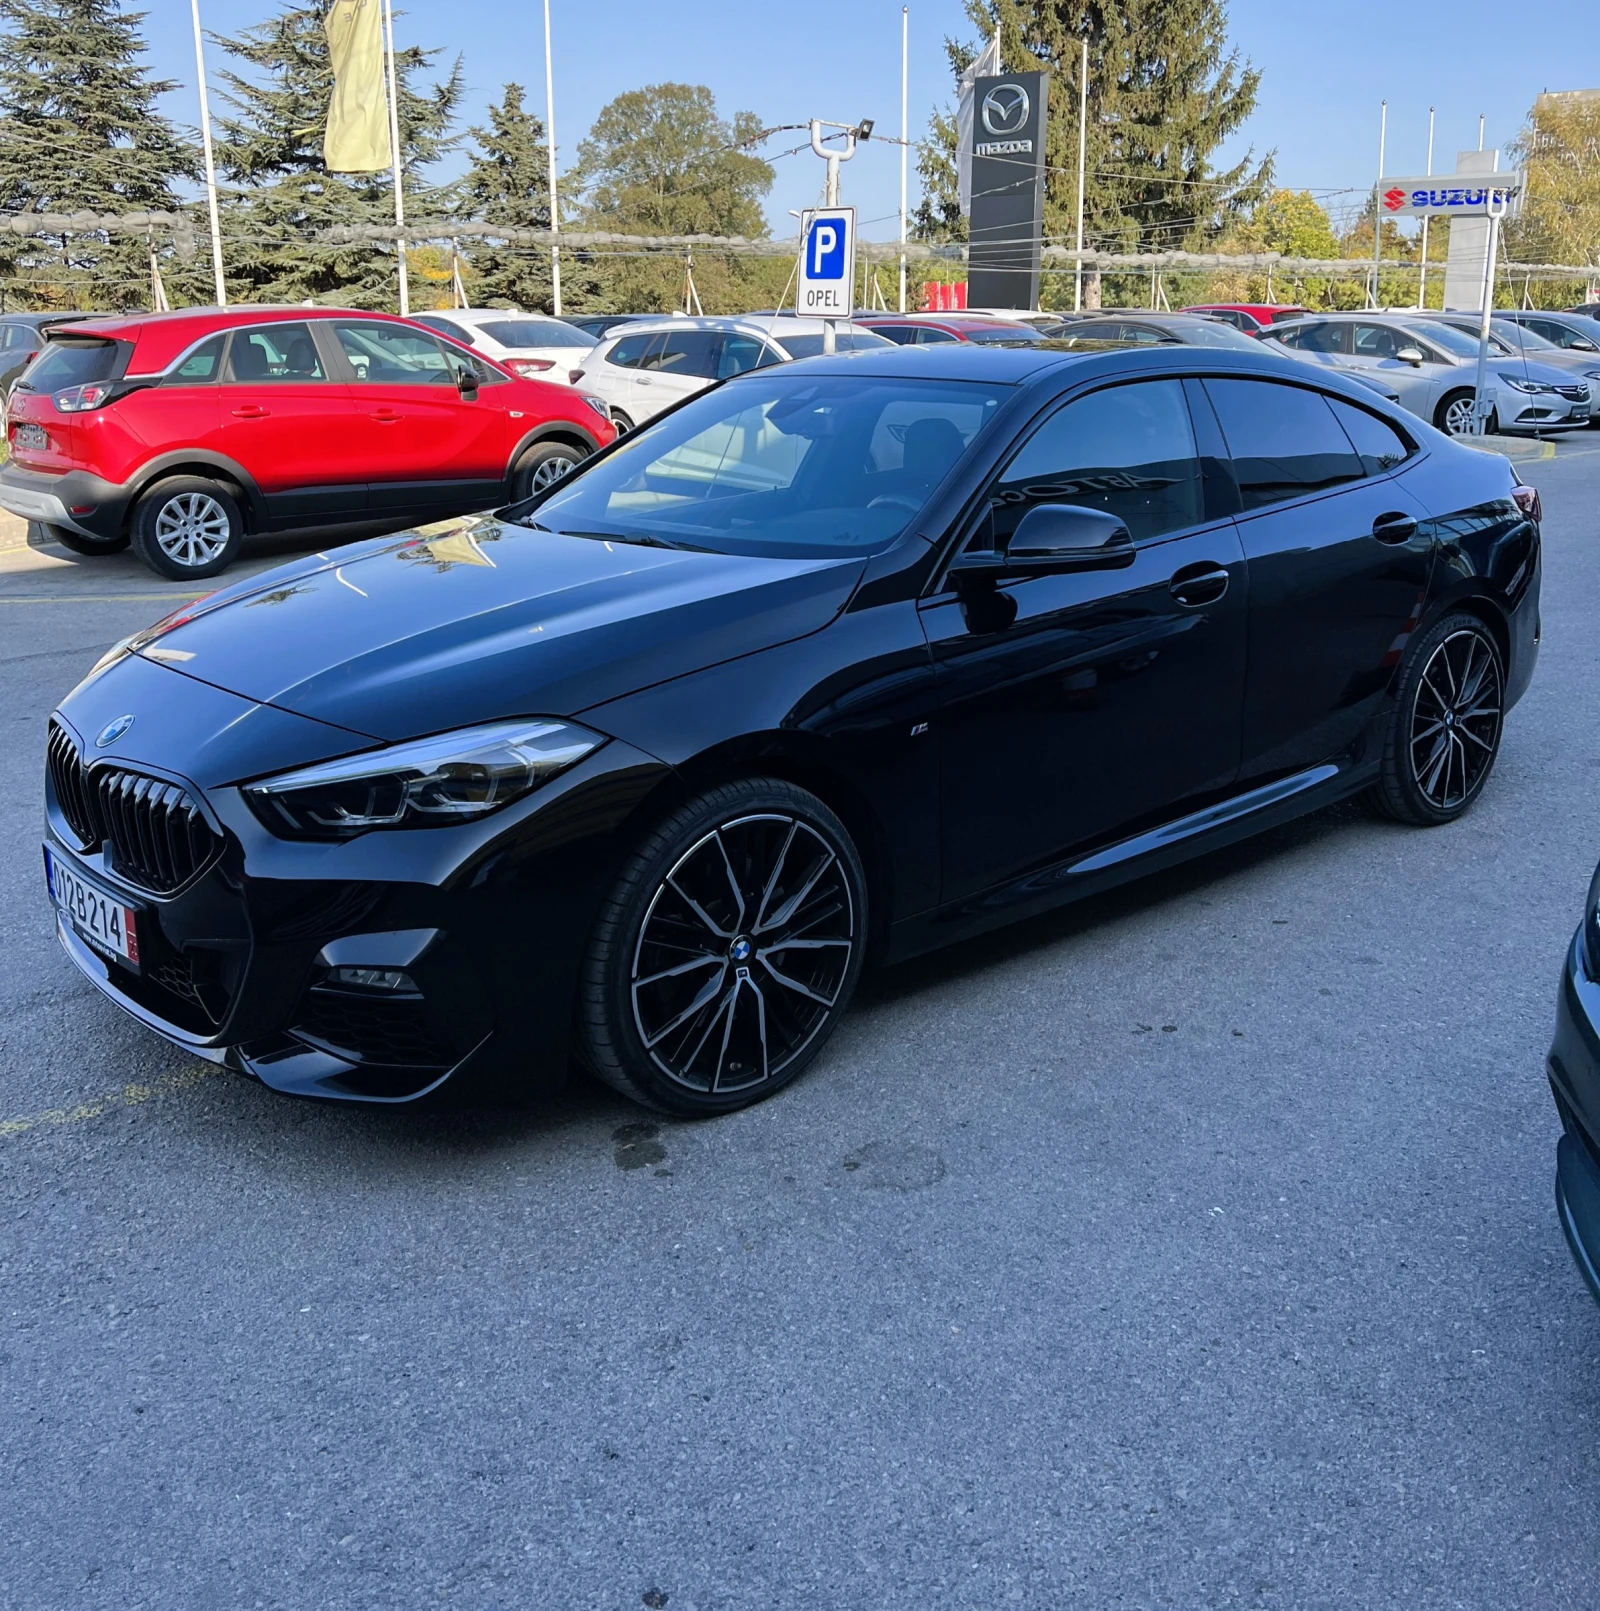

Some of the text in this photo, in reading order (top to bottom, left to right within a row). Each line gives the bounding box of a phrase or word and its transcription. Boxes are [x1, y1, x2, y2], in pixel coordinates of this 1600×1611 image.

[814, 226, 837, 274] P
[807, 290, 839, 306] OPEL
[54, 861, 121, 947] 012B214
